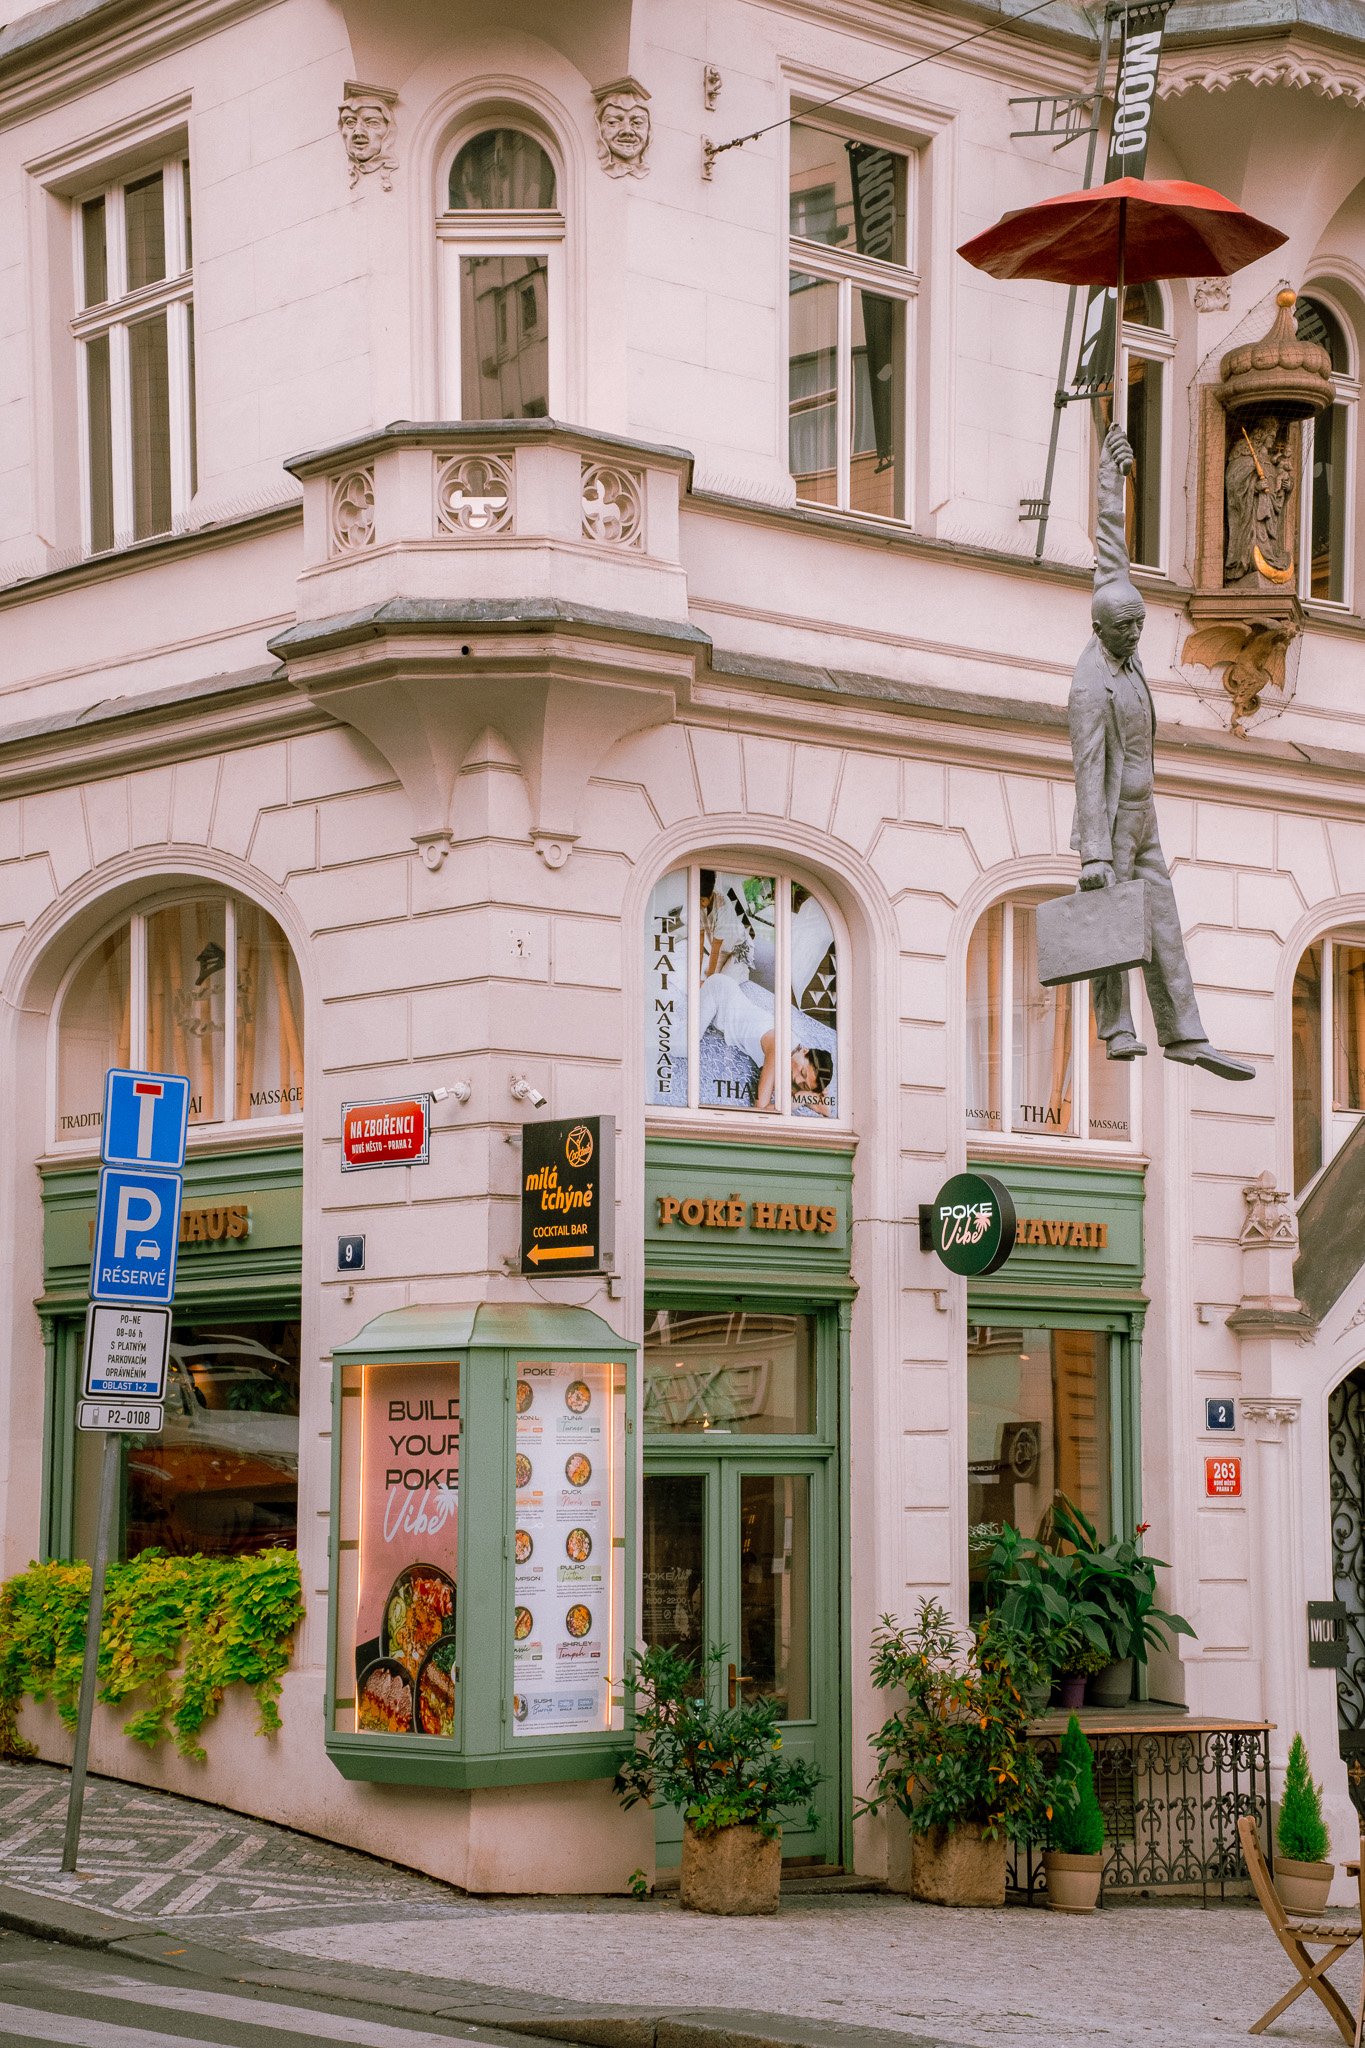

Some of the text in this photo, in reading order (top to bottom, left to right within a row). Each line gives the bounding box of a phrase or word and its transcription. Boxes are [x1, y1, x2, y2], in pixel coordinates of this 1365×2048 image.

[654, 916, 675, 1093] THAI MASSAGE
[188, 1096, 202, 1114] AI
[250, 1087, 303, 1106] MASSAGE
[792, 1094, 836, 1106] MASSAGE
[1021, 1104, 1062, 1125] THAI
[1089, 1118, 1128, 1130] MASSAGE
[350, 1114, 414, 1139] NA ZBOŘENCI
[351, 1142, 365, 1154] NOVÉ
[365, 1141, 383, 1153] MĚSTO
[388, 1139, 407, 1151] PRAHA
[407, 1138, 412, 1149] 2
[525, 1165, 558, 1191] milá
[541, 1182, 593, 1214] tchýně
[658, 1193, 838, 1233] POKÉ HAUS
[939, 1202, 993, 1220] POKE
[114, 1186, 162, 1258] P
[533, 1223, 588, 1238] COCKTAIL BAR
[941, 1217, 985, 1251] Vibe
[345, 1244, 353, 1262] 9
[101, 1265, 167, 1286] RÉSERVÉ
[120, 1314, 141, 1325] PO-NE
[116, 1328, 143, 1339] 08-06 h
[110, 1340, 147, 1352] S PLATNÝM
[107, 1354, 147, 1365] PARKOVACÍM
[105, 1366, 147, 1379] OPRÁVNĚNÍM
[522, 1368, 557, 1376] POKE
[102, 1381, 132, 1391] OBLAST
[107, 1411, 150, 1425] P2-0108
[388, 1399, 460, 1421] BUILD
[1218, 1406, 1226, 1423] 2
[388, 1434, 460, 1456] YOUR
[385, 1468, 459, 1491] POKE
[1213, 1462, 1236, 1479] 263
[383, 1485, 448, 1543] Vibe
